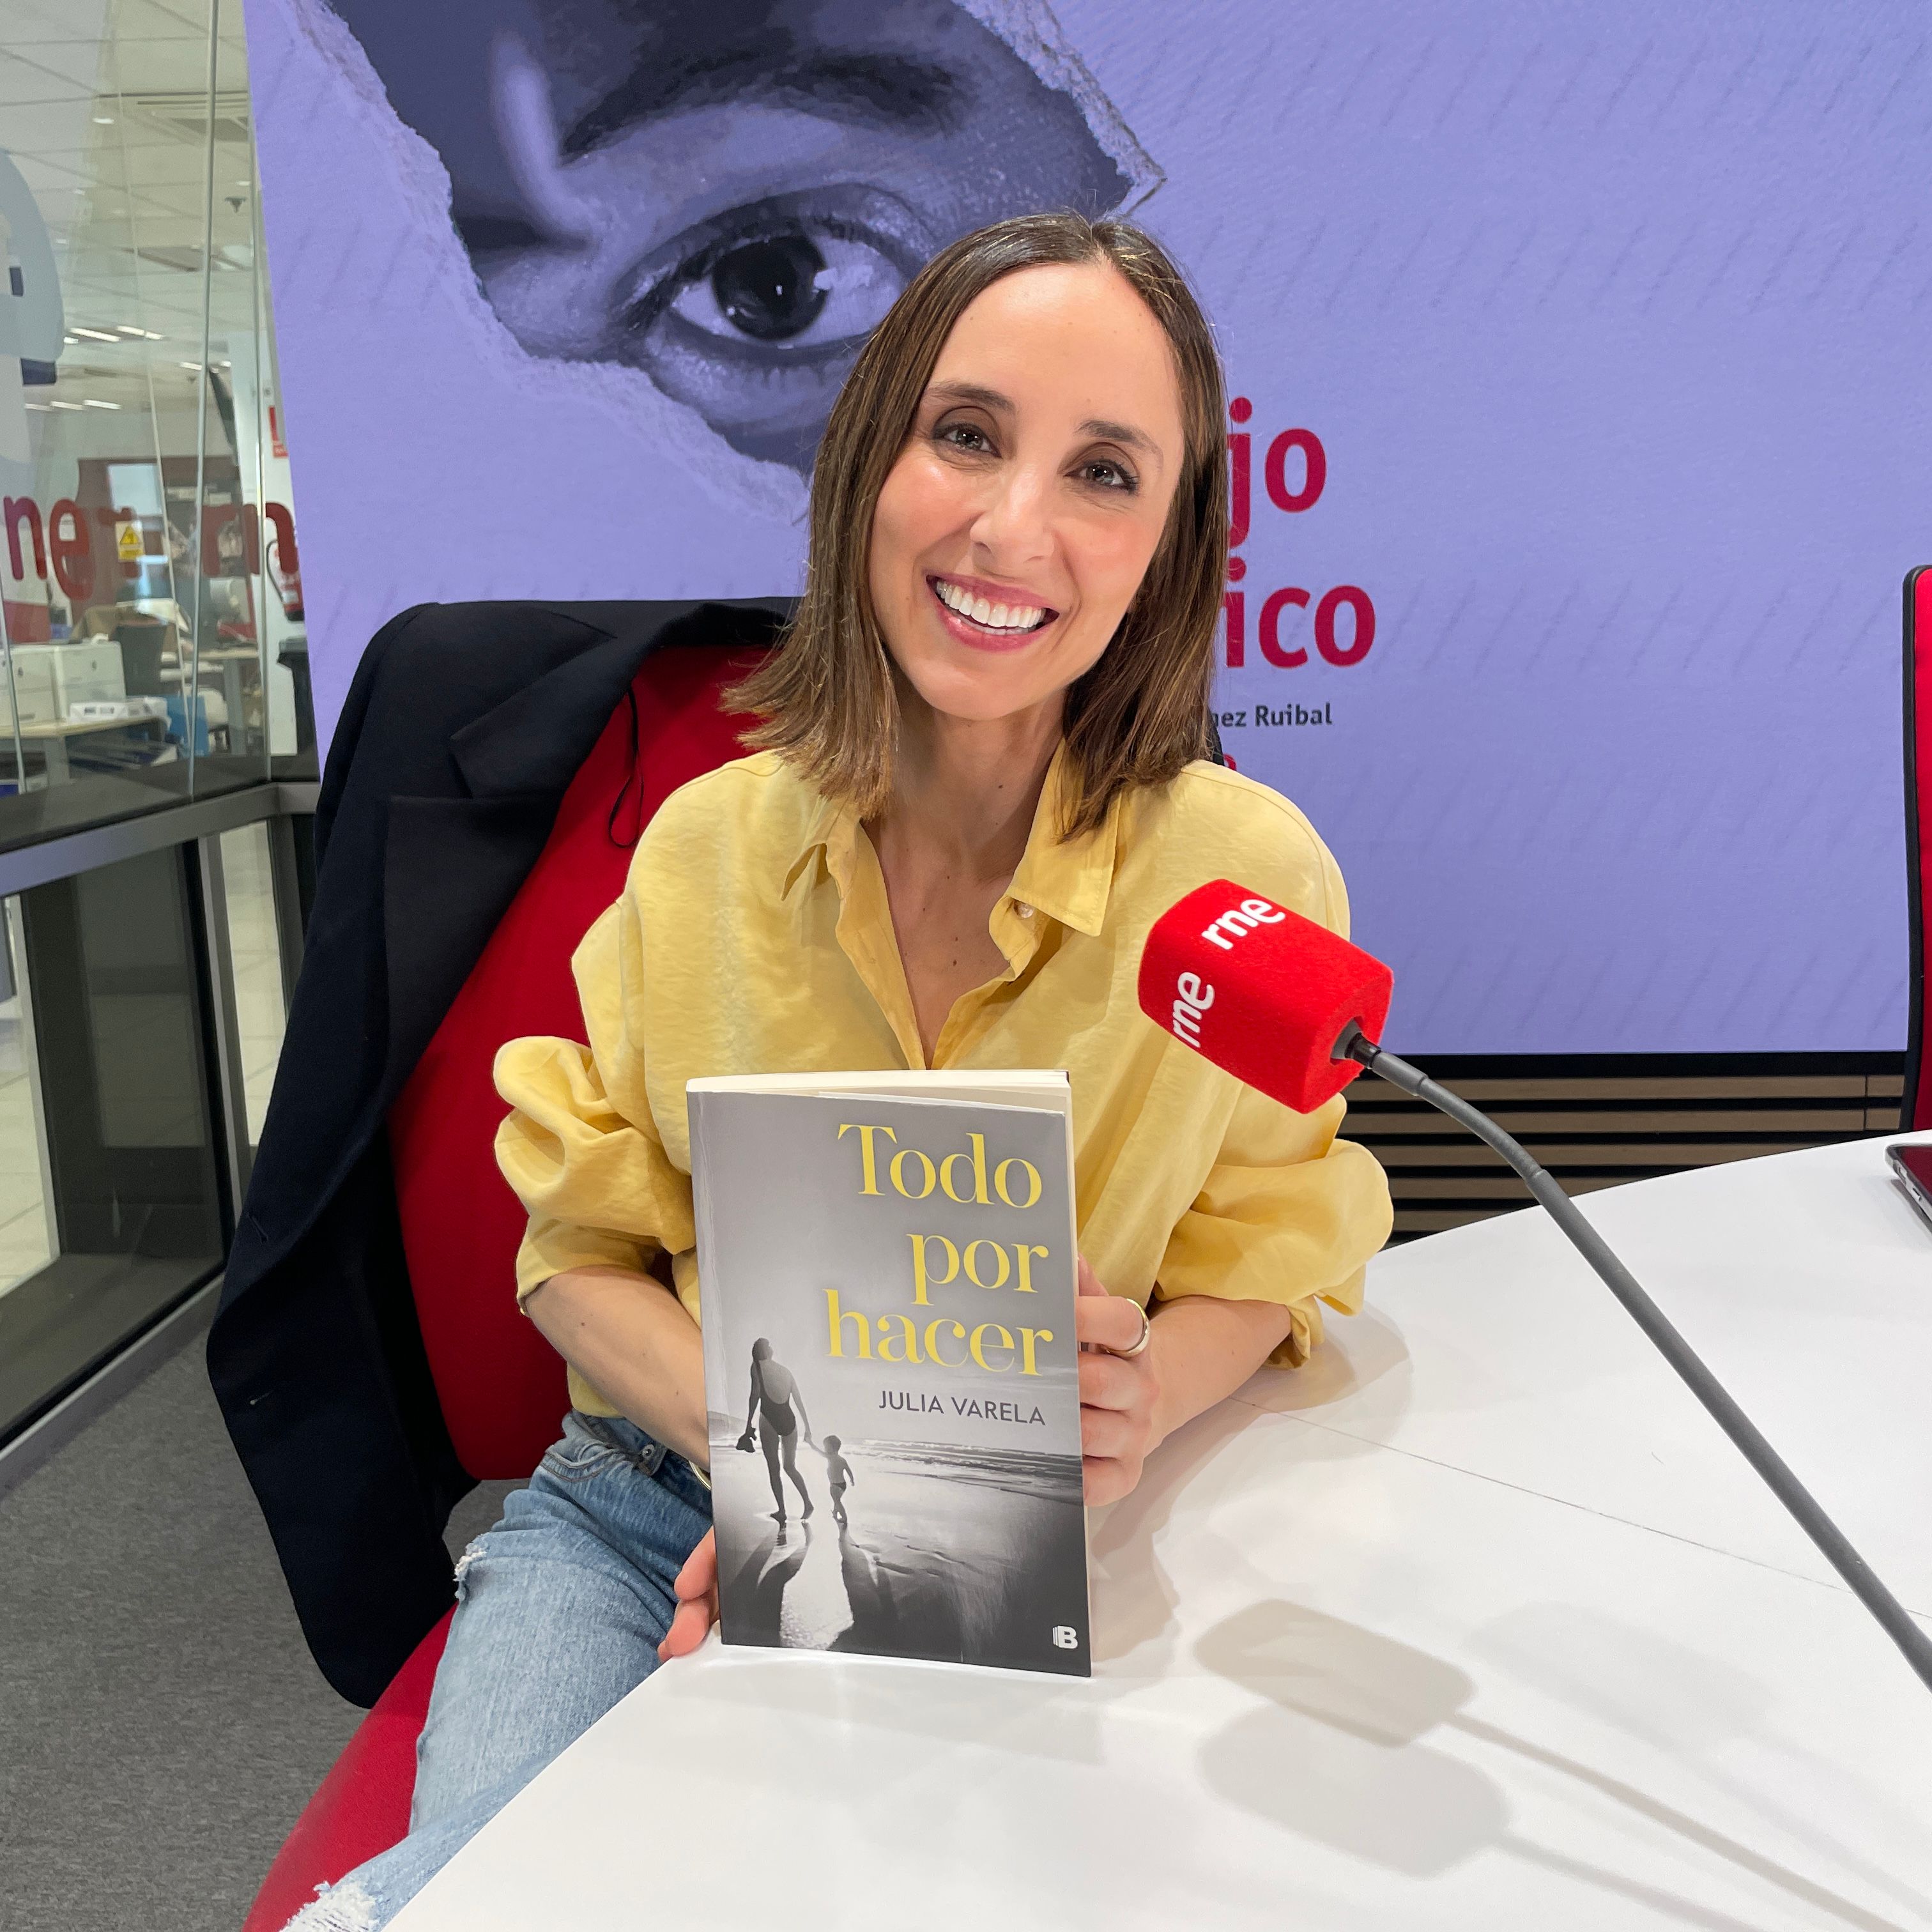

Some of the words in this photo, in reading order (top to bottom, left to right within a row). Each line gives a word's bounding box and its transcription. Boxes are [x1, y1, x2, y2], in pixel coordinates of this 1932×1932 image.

[1255, 702, 1333, 727] Ruibal
[1201, 898, 1286, 951] rne
[1172, 972, 1215, 1048] rne
[838, 1123, 1043, 1208] Todo
[906, 1234, 1050, 1306] por
[822, 1289, 1054, 1376] hacer
[878, 1390, 944, 1414] JULIA
[951, 1397, 1046, 1425] VARELA
